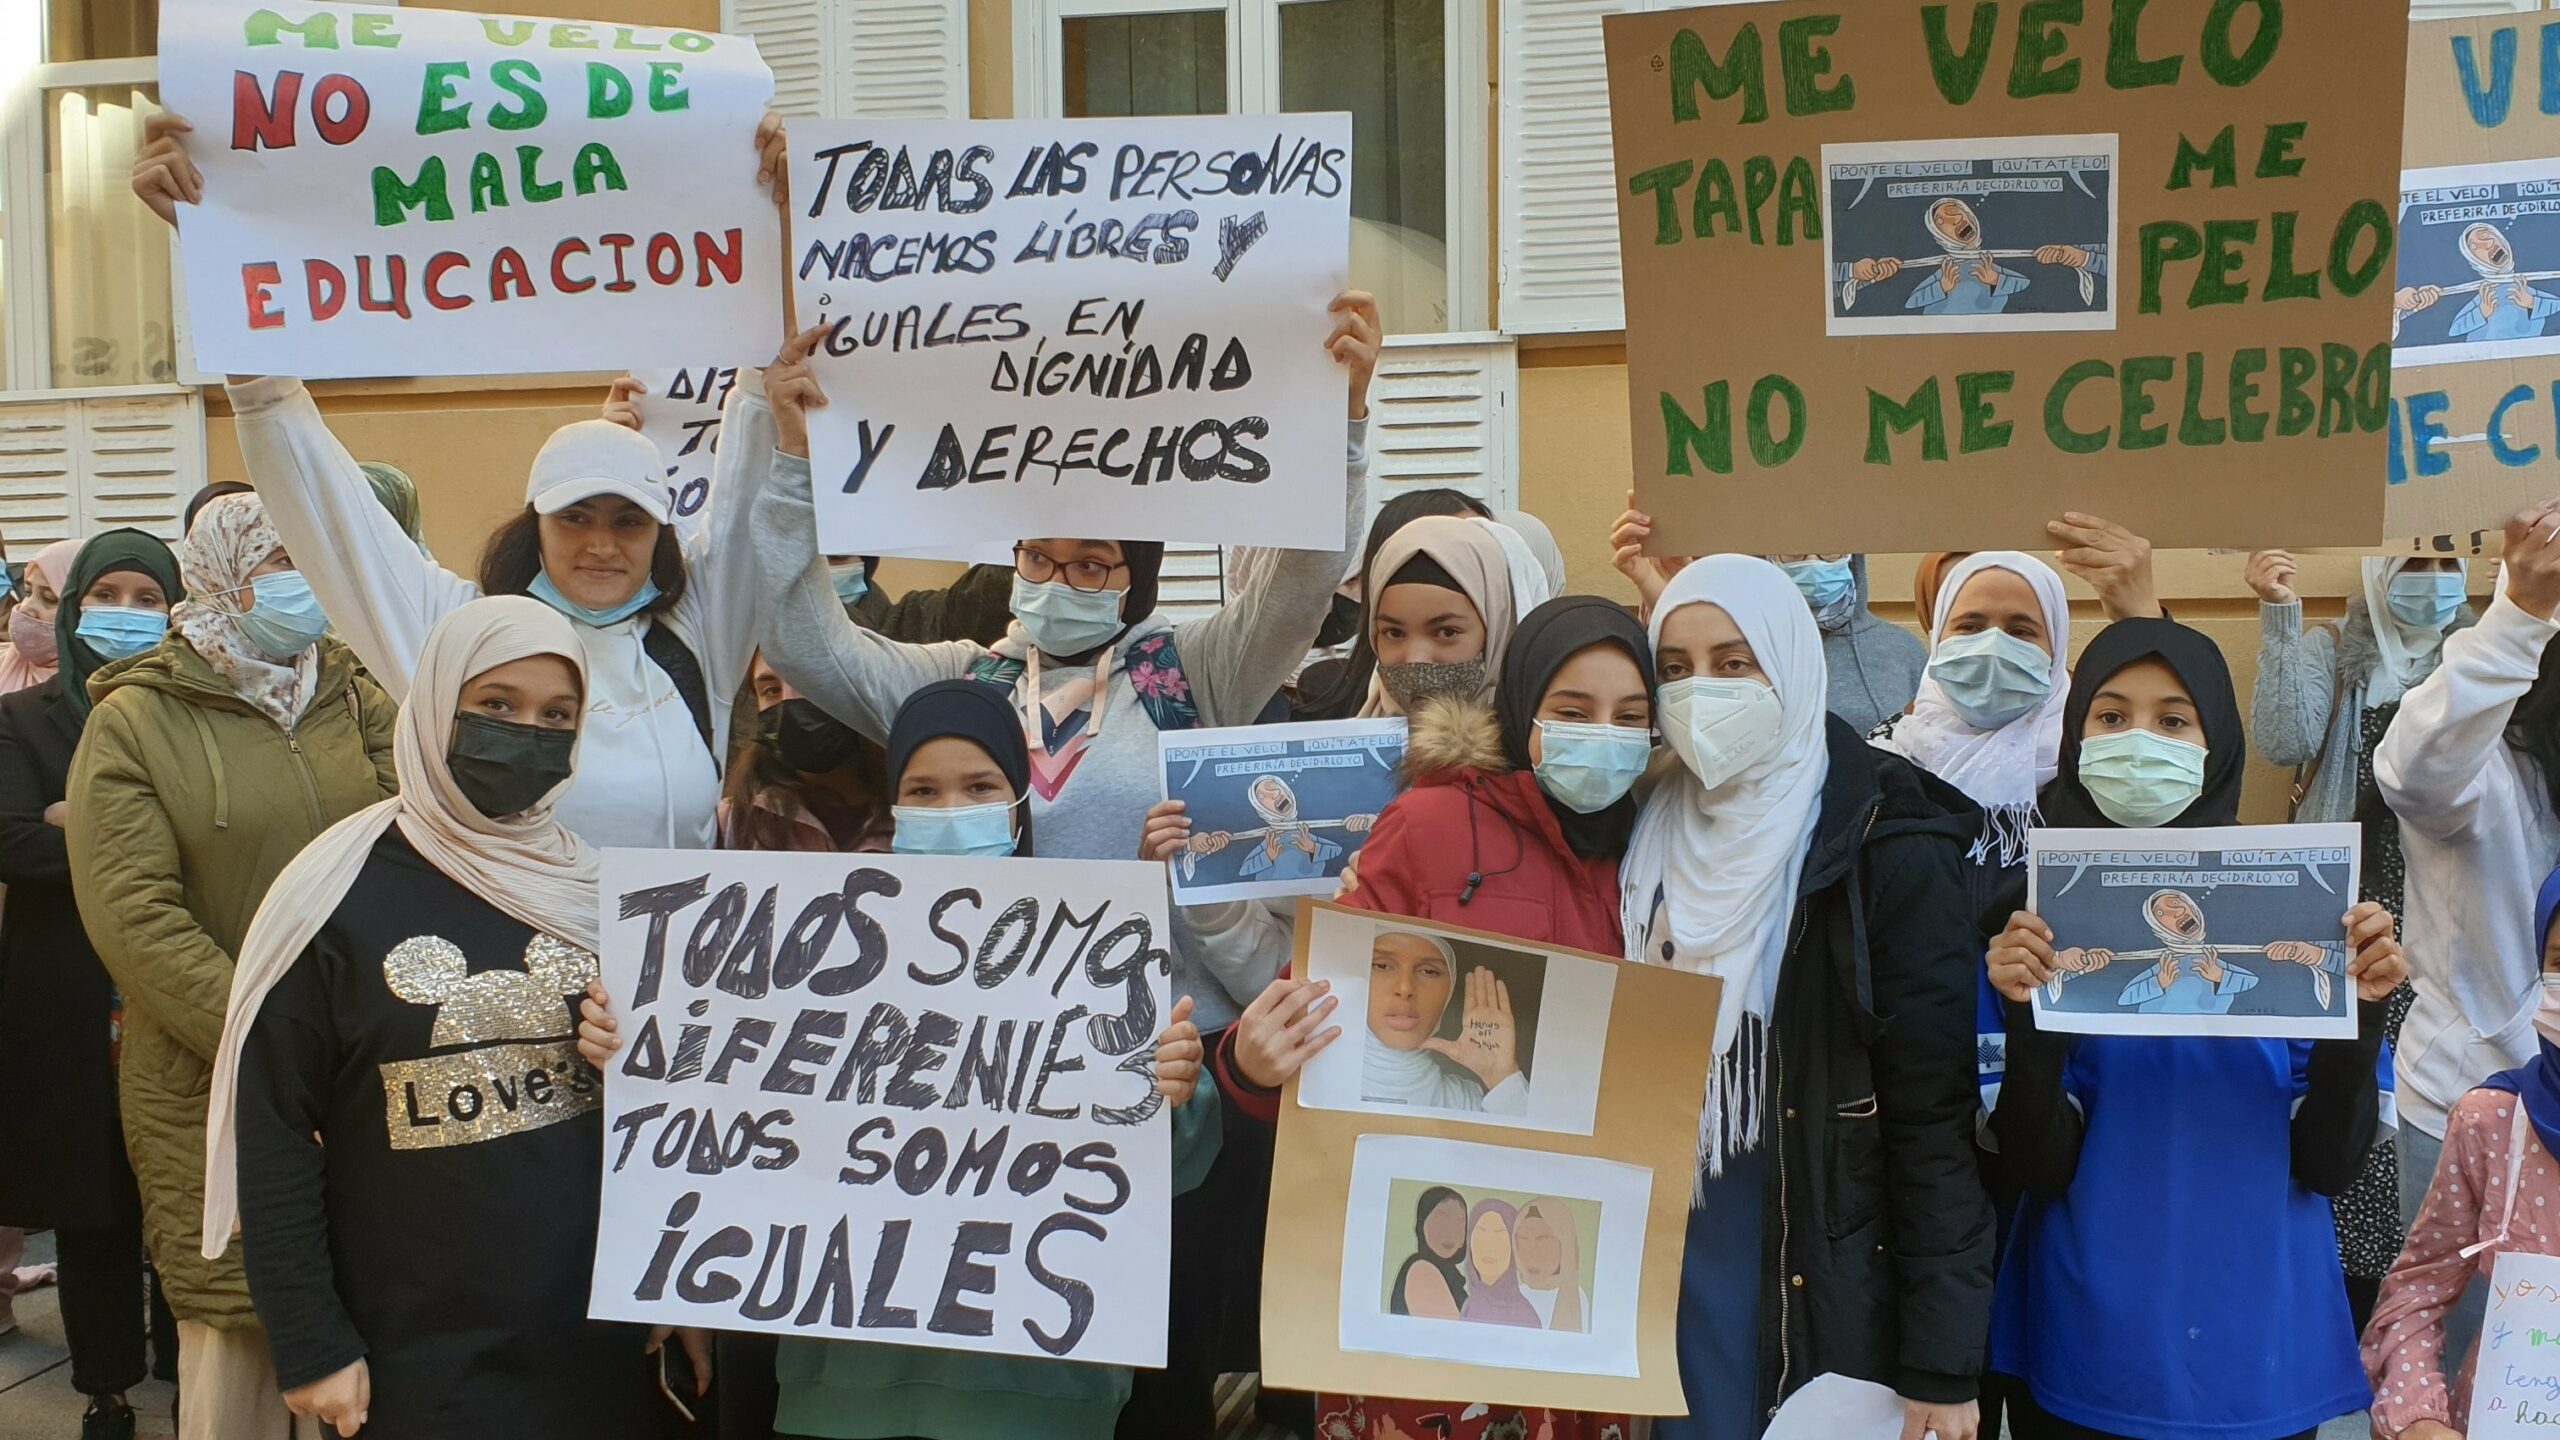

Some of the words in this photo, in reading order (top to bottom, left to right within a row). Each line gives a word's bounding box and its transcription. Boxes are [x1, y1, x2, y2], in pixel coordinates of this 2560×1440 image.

[243, 8, 403, 51] ME
[477, 17, 716, 54] VELO
[1667, 13, 1856, 125] ME
[1920, 0, 2284, 106] VELO
[230, 68, 371, 153] NO
[415, 59, 549, 137] ES
[585, 60, 691, 120] DE
[371, 141, 629, 226] MALA
[808, 140, 994, 218] TODAS
[1004, 141, 1098, 200] LAS
[1109, 133, 1345, 202] PERSONAS
[1894, 164, 1913, 175] EL
[2165, 120, 2309, 191] ME
[2426, 191, 2444, 202] EL
[1629, 154, 1823, 247] TAPA
[240, 227, 743, 330] EDUCACION
[799, 232, 997, 282] NACEMOS
[1211, 210, 1269, 283] Y
[2137, 197, 2394, 315] PELO
[1065, 297, 1146, 341] EN
[1659, 373, 1806, 477] NO
[1864, 369, 2016, 465] ME
[2043, 340, 2392, 455] CELEBRO
[841, 419, 895, 493] Y
[916, 416, 1271, 490] DERECHOS
[1221, 746, 1236, 756] EL
[2110, 852, 2130, 863] EL
[618, 868, 901, 1012] TODOS
[907, 887, 1172, 1056] SOMOS
[611, 1103, 800, 1175] TODOS
[838, 1116, 1131, 1215] SOMOS
